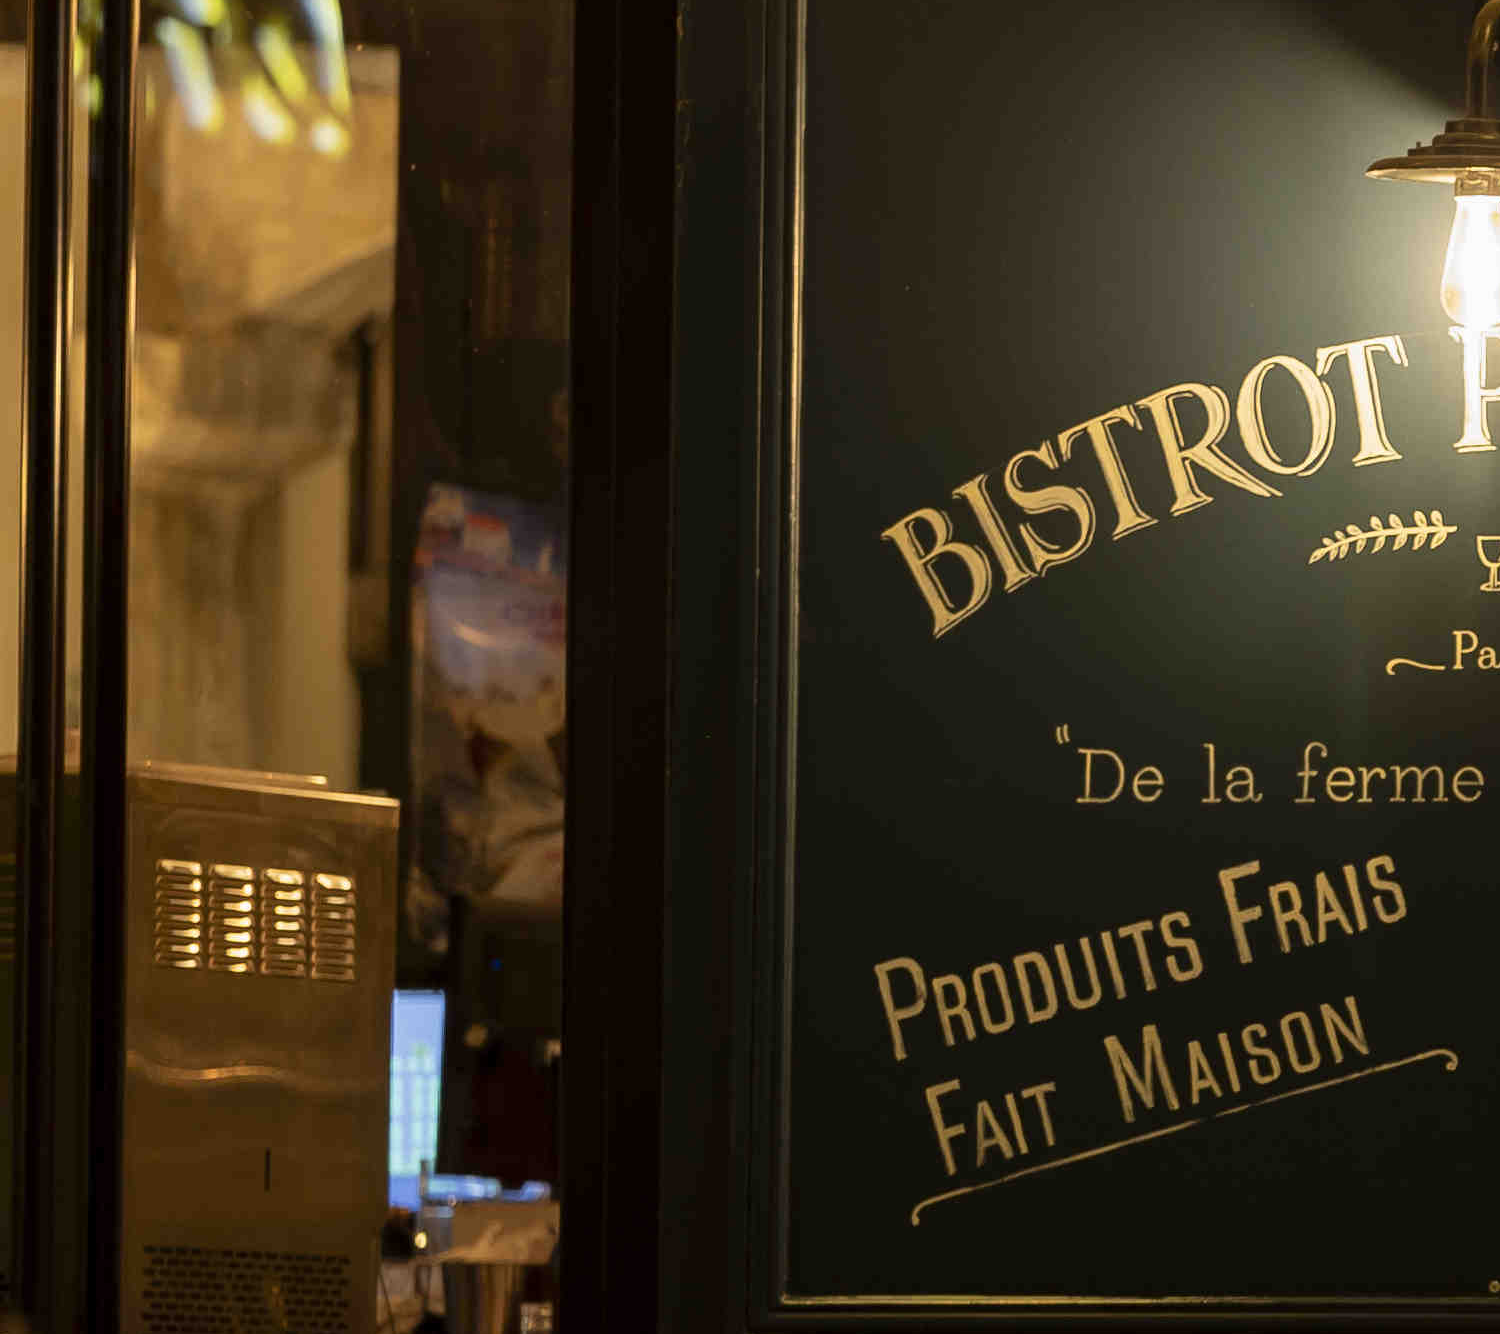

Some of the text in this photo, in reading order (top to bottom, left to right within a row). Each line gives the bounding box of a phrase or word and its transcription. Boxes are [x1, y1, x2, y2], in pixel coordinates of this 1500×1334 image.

[880, 331, 1408, 639] BISTROT
[1201, 740, 1265, 805] la
[1293, 740, 1486, 805] ferme
[874, 852, 1409, 1059] PRODUITS FRAIS
[924, 995, 1372, 1176] FAIT MAISON
